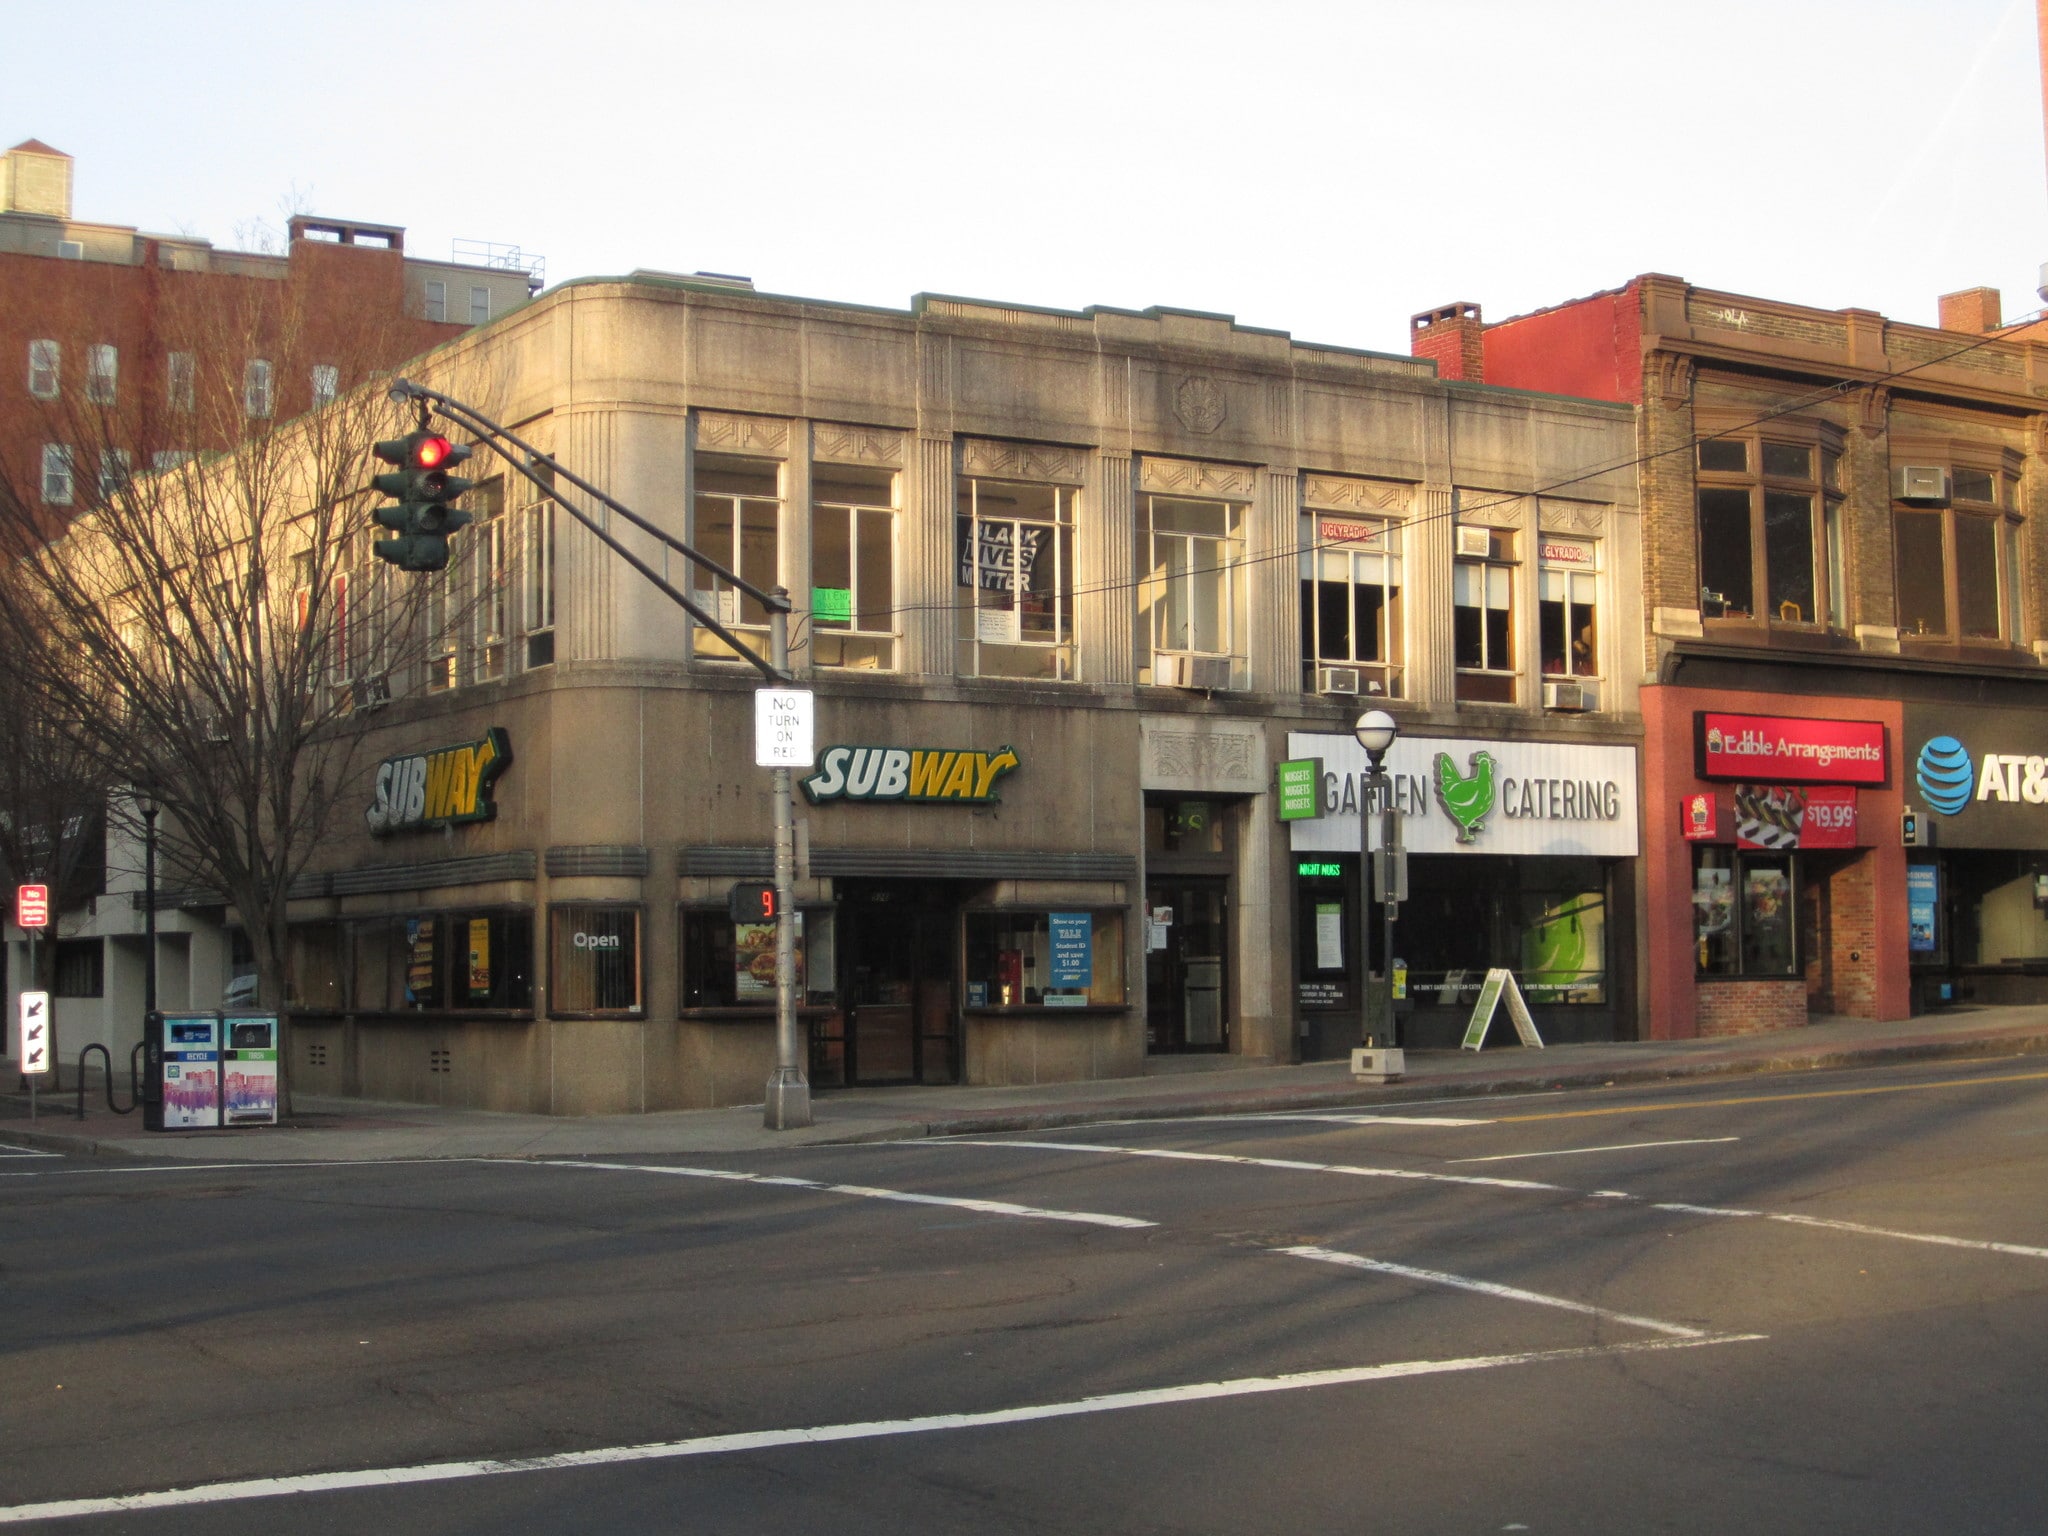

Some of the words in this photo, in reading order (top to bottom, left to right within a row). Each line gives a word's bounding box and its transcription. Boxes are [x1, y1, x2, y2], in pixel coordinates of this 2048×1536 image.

[968, 521, 1041, 546] BLACK
[1321, 523, 1369, 540] UGLYRADIO
[963, 540, 1035, 568] LIVES
[1540, 545, 1582, 560] UGLYRADIO
[962, 565, 1031, 592] MATTER
[773, 697, 796, 710] NO
[768, 715, 800, 726] TURN
[777, 731, 793, 742] ON
[1724, 730, 1773, 756] Edible
[1775, 737, 1880, 767] Arrangements
[809, 746, 1018, 798] SUBWAY
[1284, 770, 1311, 782] NUGGETS
[1976, 753, 2048, 804] AT&
[366, 737, 495, 829] SUBWAY
[1285, 784, 1311, 796] NUGGETS
[1285, 798, 1311, 810] NUGGETS
[1503, 777, 1618, 820] CATERING
[1807, 805, 1853, 828] $19.99
[1299, 864, 1320, 876] NIGHT
[1321, 864, 1341, 876] NUGS
[26, 890, 40, 898] No
[762, 891, 772, 916] 9
[573, 932, 619, 950] Open
[186, 1052, 208, 1060] RECYCLE
